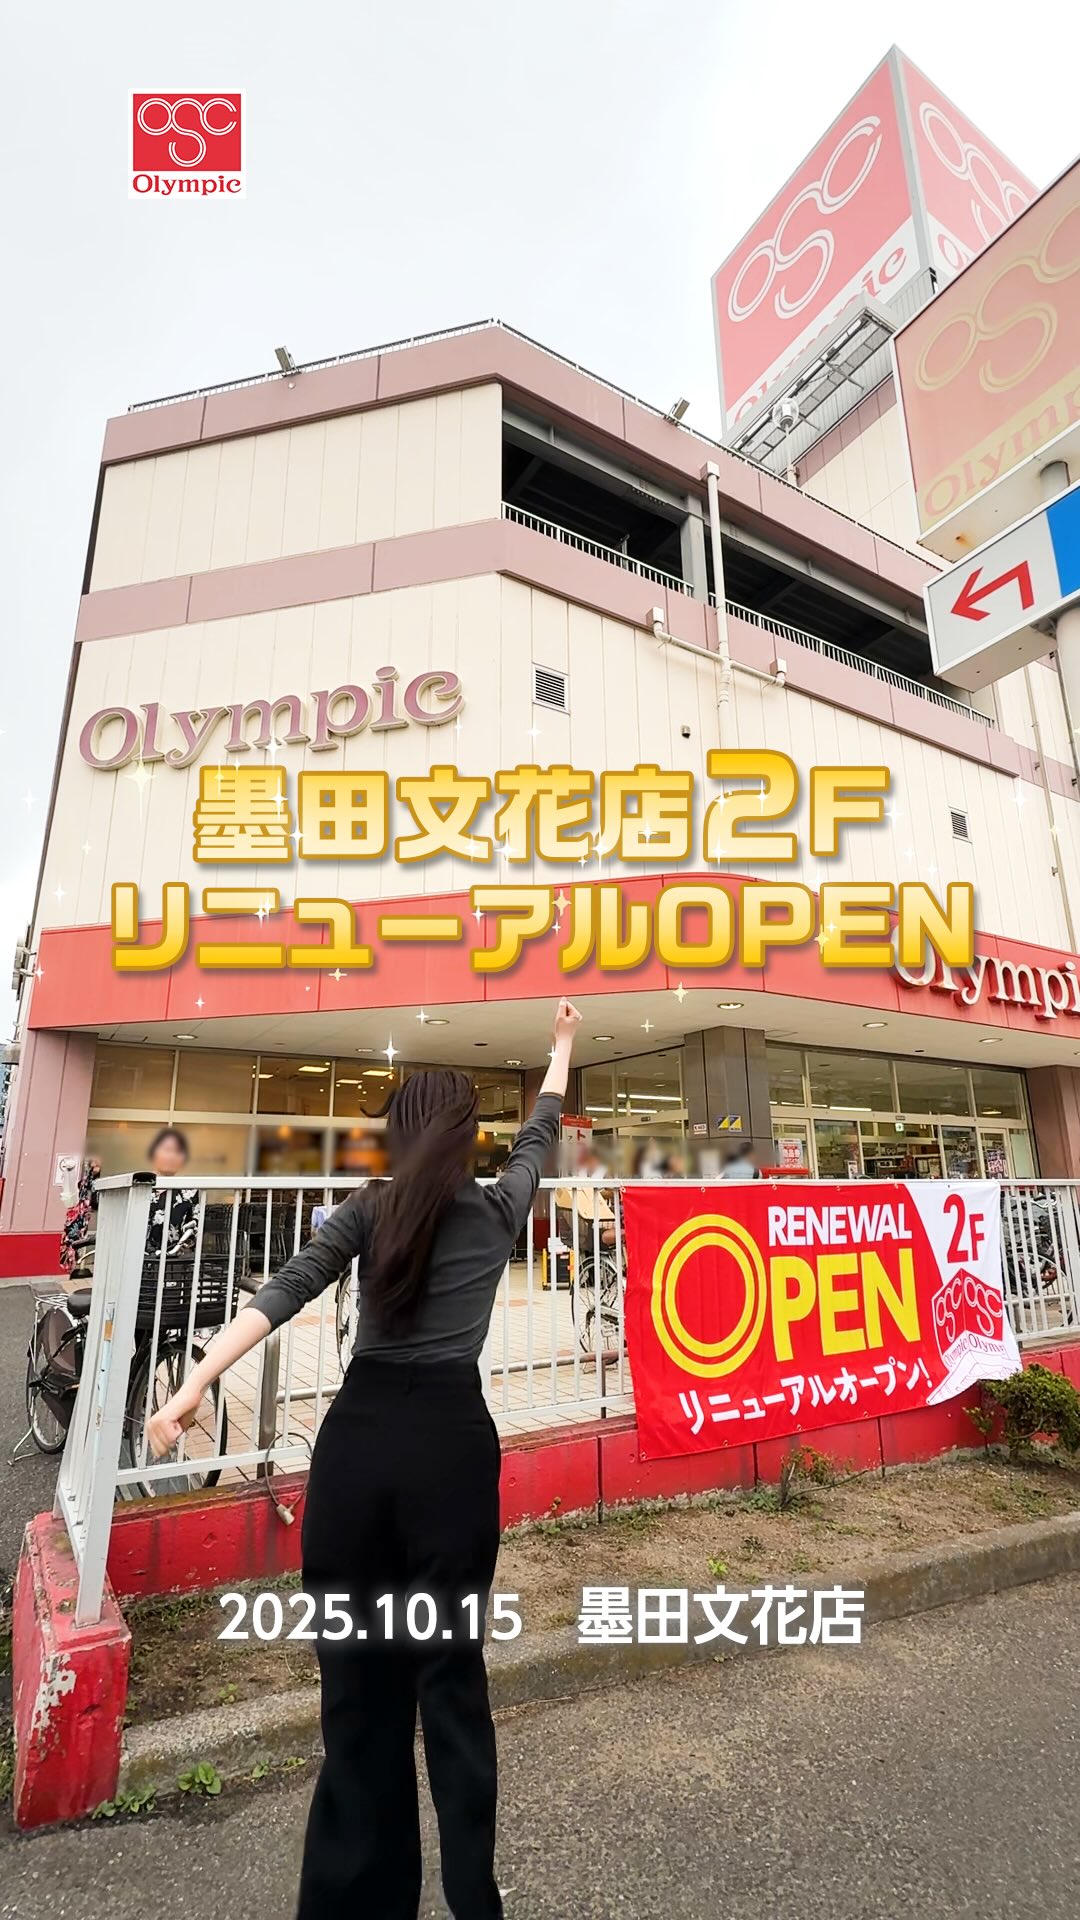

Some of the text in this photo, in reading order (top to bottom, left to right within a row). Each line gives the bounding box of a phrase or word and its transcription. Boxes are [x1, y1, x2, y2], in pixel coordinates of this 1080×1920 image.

[79, 665, 464, 771] Olympic
[768, 1203, 912, 1247] RENEWAL
[943, 1193, 985, 1263] 2F
[651, 1214, 922, 1378] OPEN
[678, 1355, 933, 1434] リニューアルオープン!
